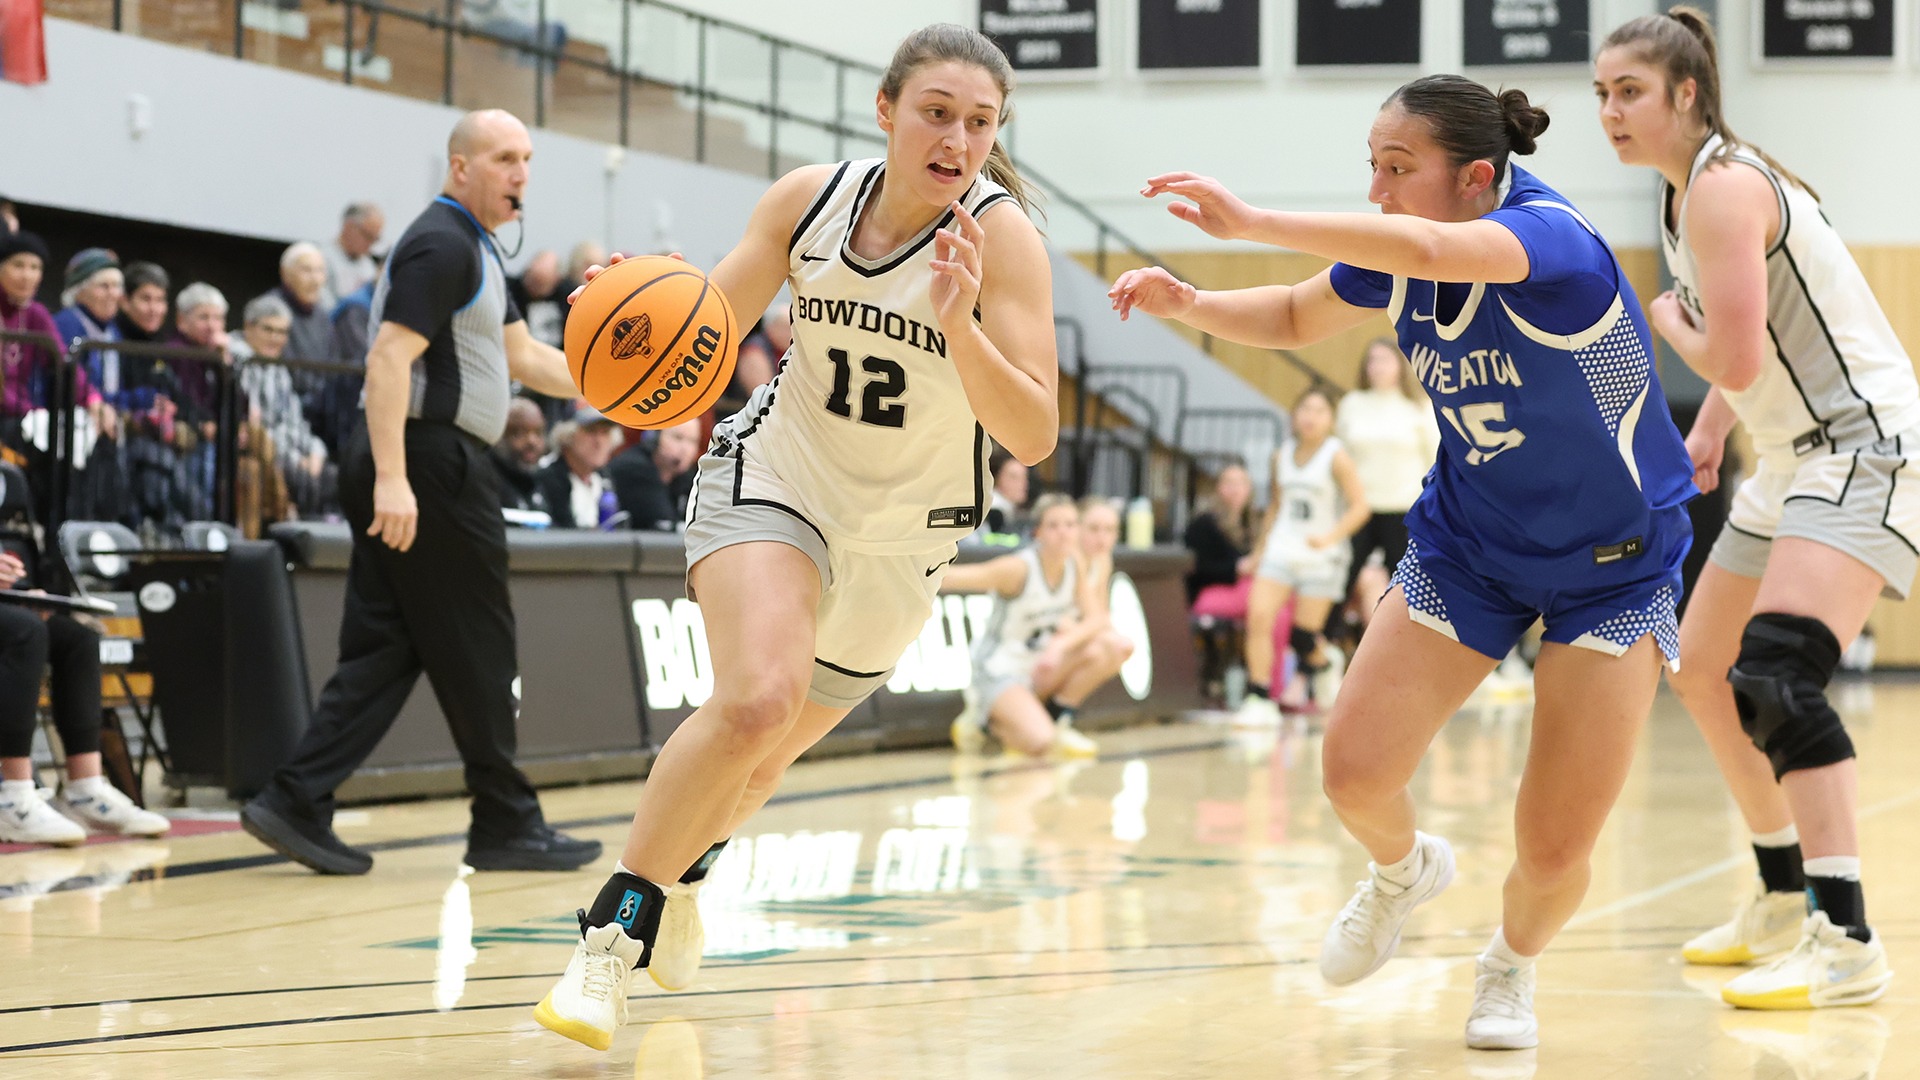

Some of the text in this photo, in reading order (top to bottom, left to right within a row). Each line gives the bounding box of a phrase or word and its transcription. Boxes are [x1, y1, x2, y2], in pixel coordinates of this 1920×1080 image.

[798, 296, 946, 359] BOWDOIN
[632, 325, 721, 414] Wilson
[825, 346, 908, 429] 12
[1411, 342, 1523, 394] WHEATON
[1440, 401, 1526, 466] 15
[960, 513, 969, 522] M
[1626, 543, 1636, 552] M
